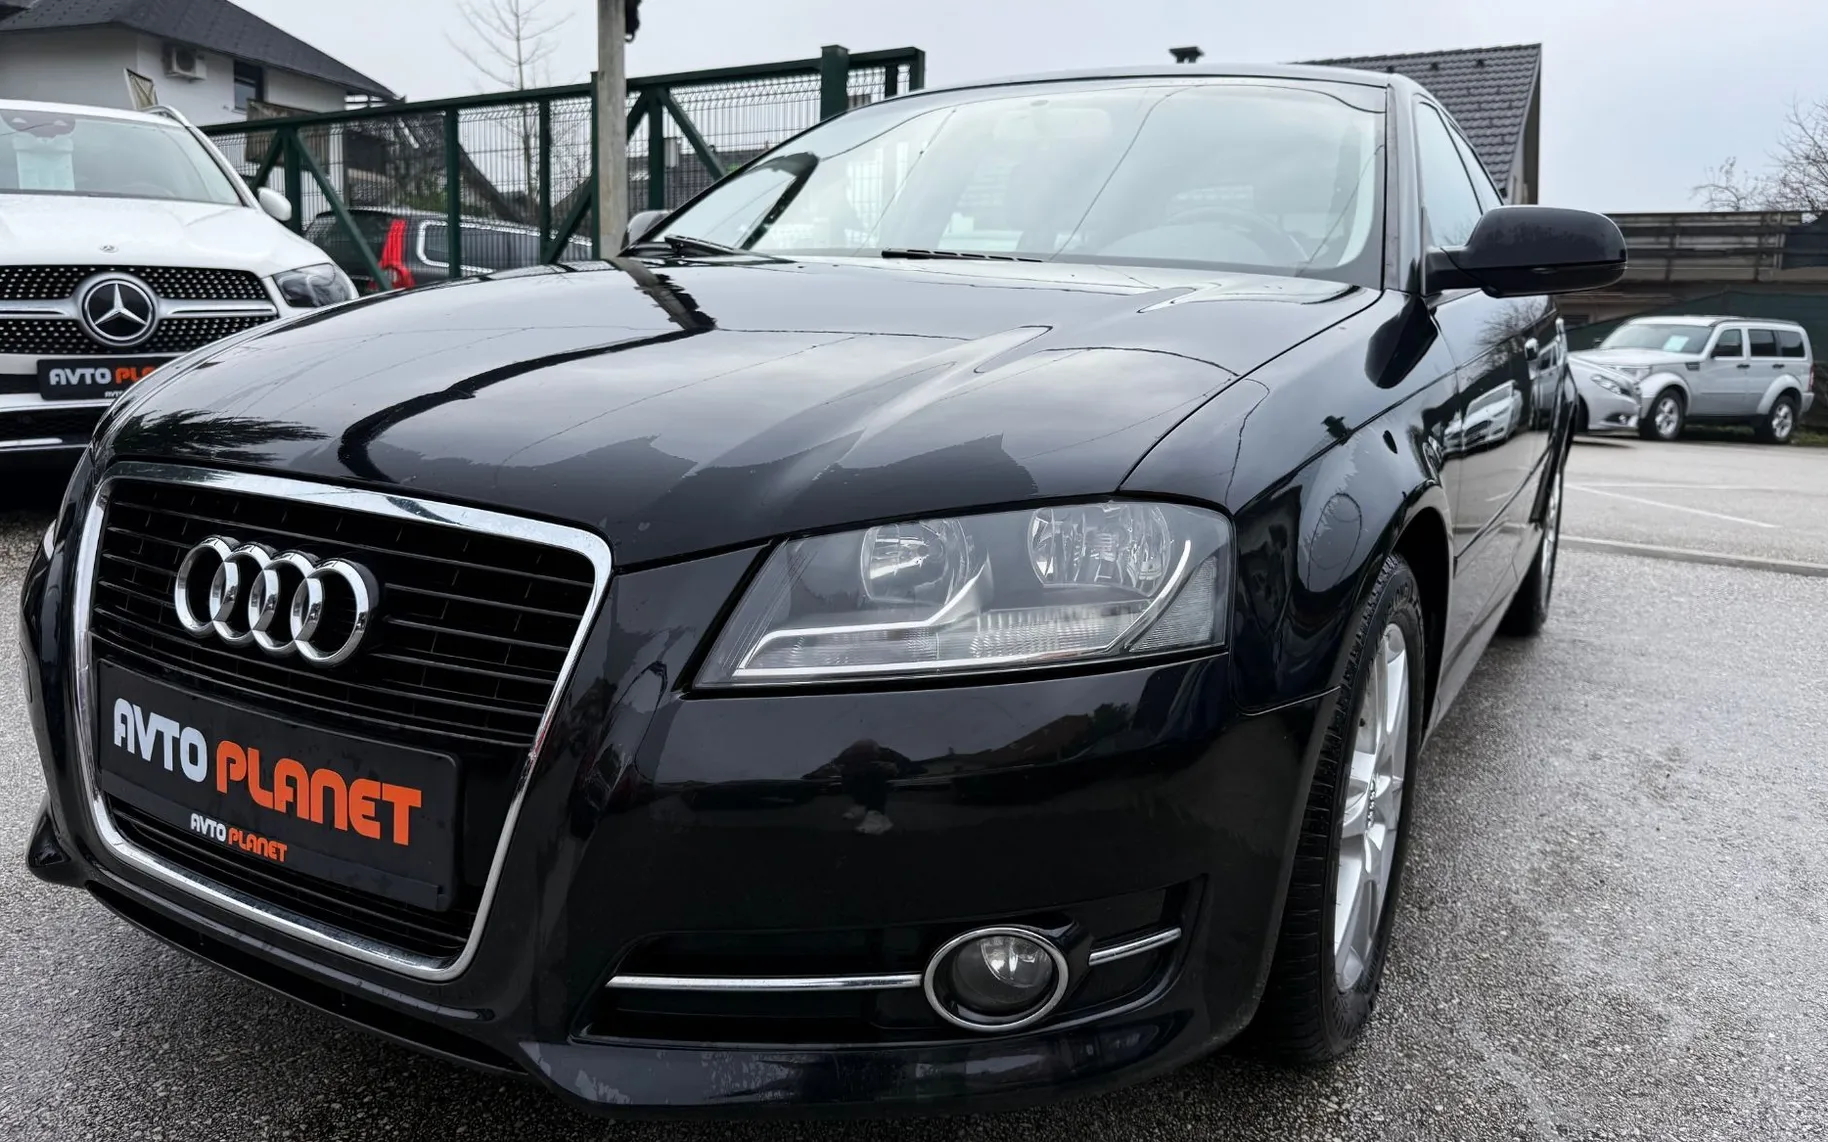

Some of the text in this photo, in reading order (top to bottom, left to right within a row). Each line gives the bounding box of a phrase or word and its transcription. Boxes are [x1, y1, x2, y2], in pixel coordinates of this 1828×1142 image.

[49, 368, 112, 385] AVTO
[113, 698, 422, 846] AVTO PLANET
[190, 812, 288, 863] AVTO PLANET
